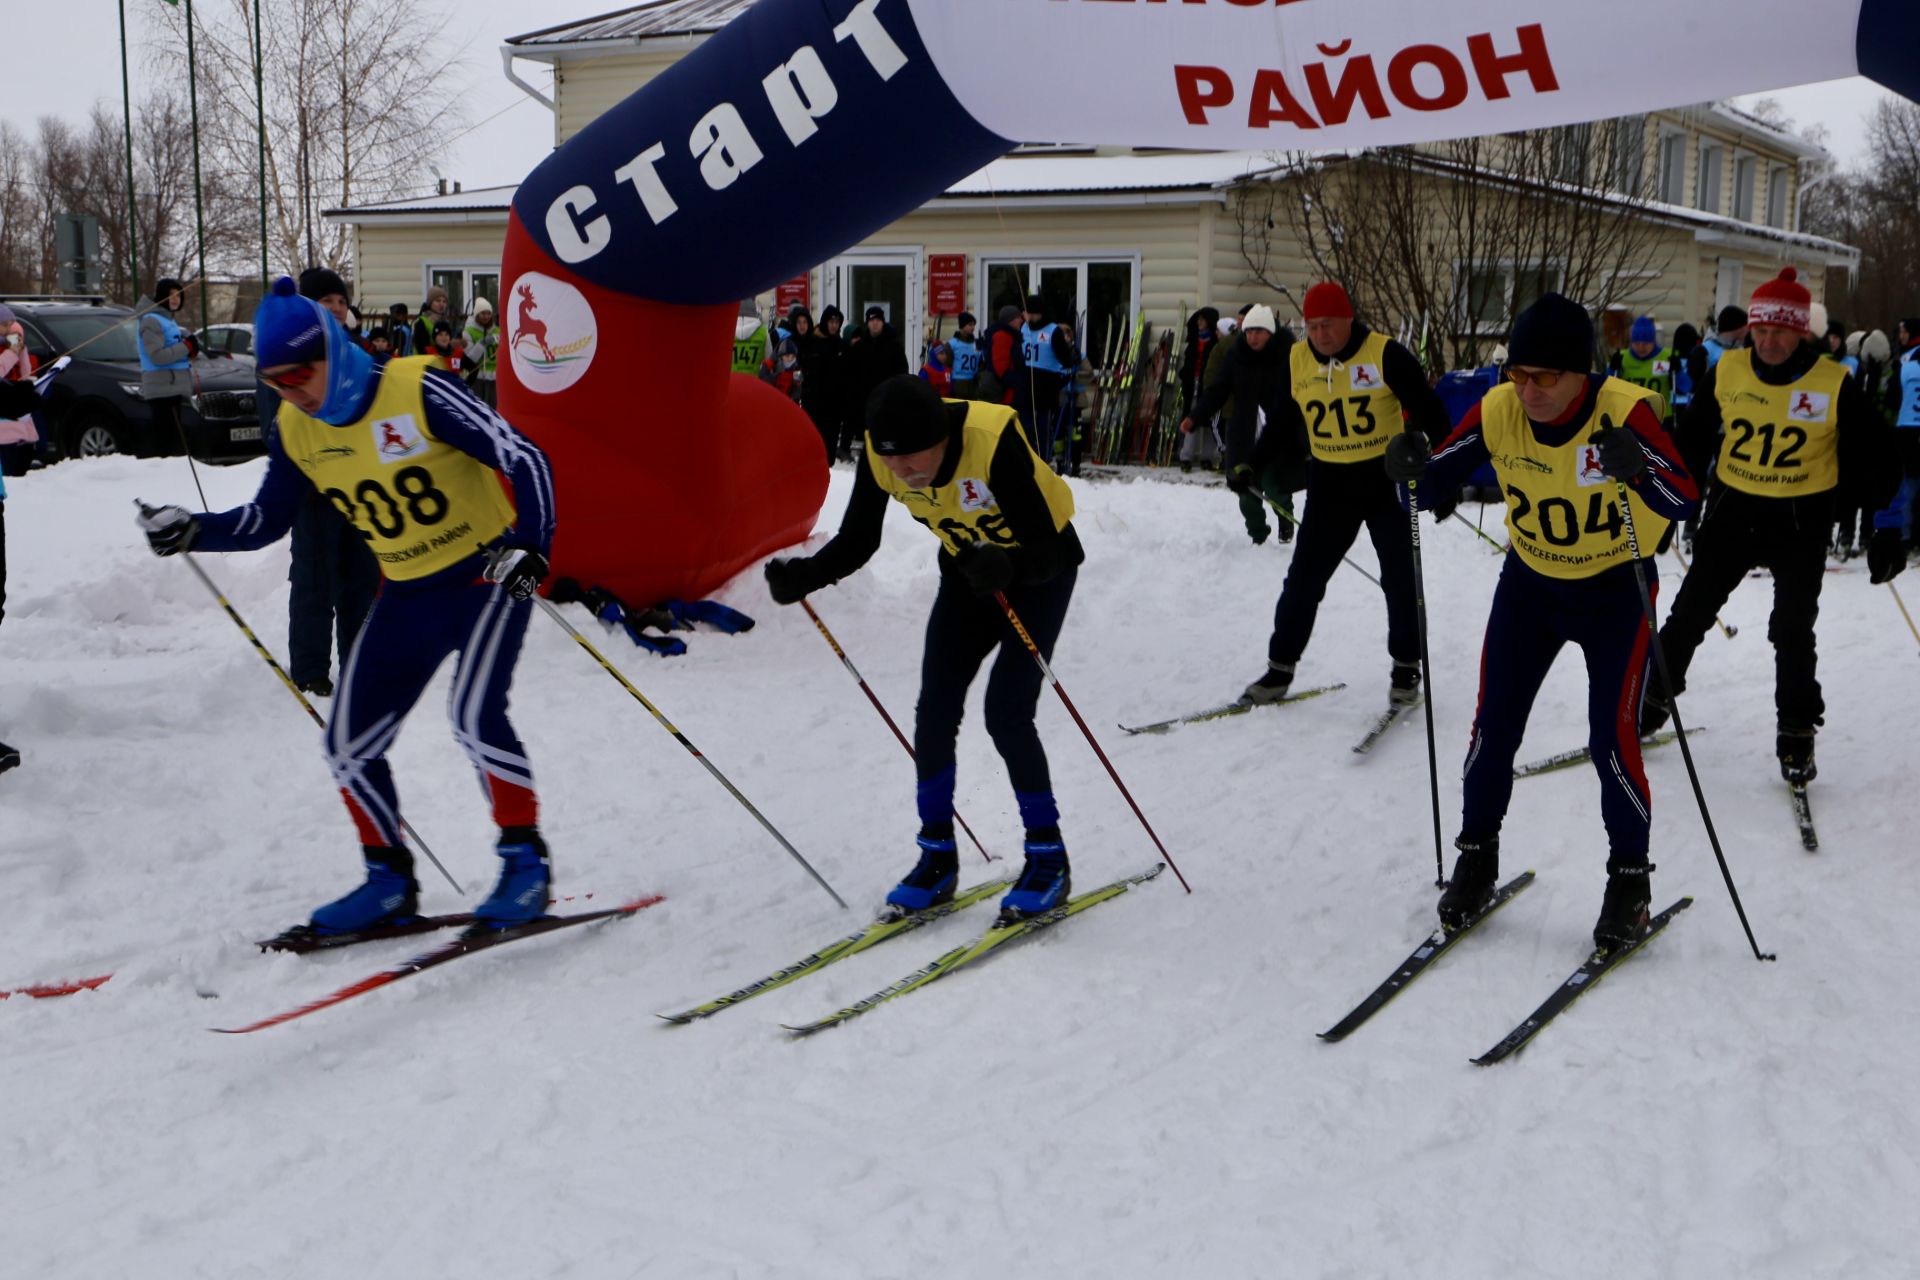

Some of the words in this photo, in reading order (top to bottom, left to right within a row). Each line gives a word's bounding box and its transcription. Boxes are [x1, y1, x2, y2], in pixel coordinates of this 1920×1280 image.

[1173, 23, 1560, 130] РАЙОН
[733, 346, 759, 365] 147
[1306, 395, 1376, 438] 213
[1729, 418, 1807, 467] 212
[1409, 493, 1420, 547] NORDWAY
[1506, 483, 1625, 547] 204
[1618, 499, 1640, 560] NORDWAY
